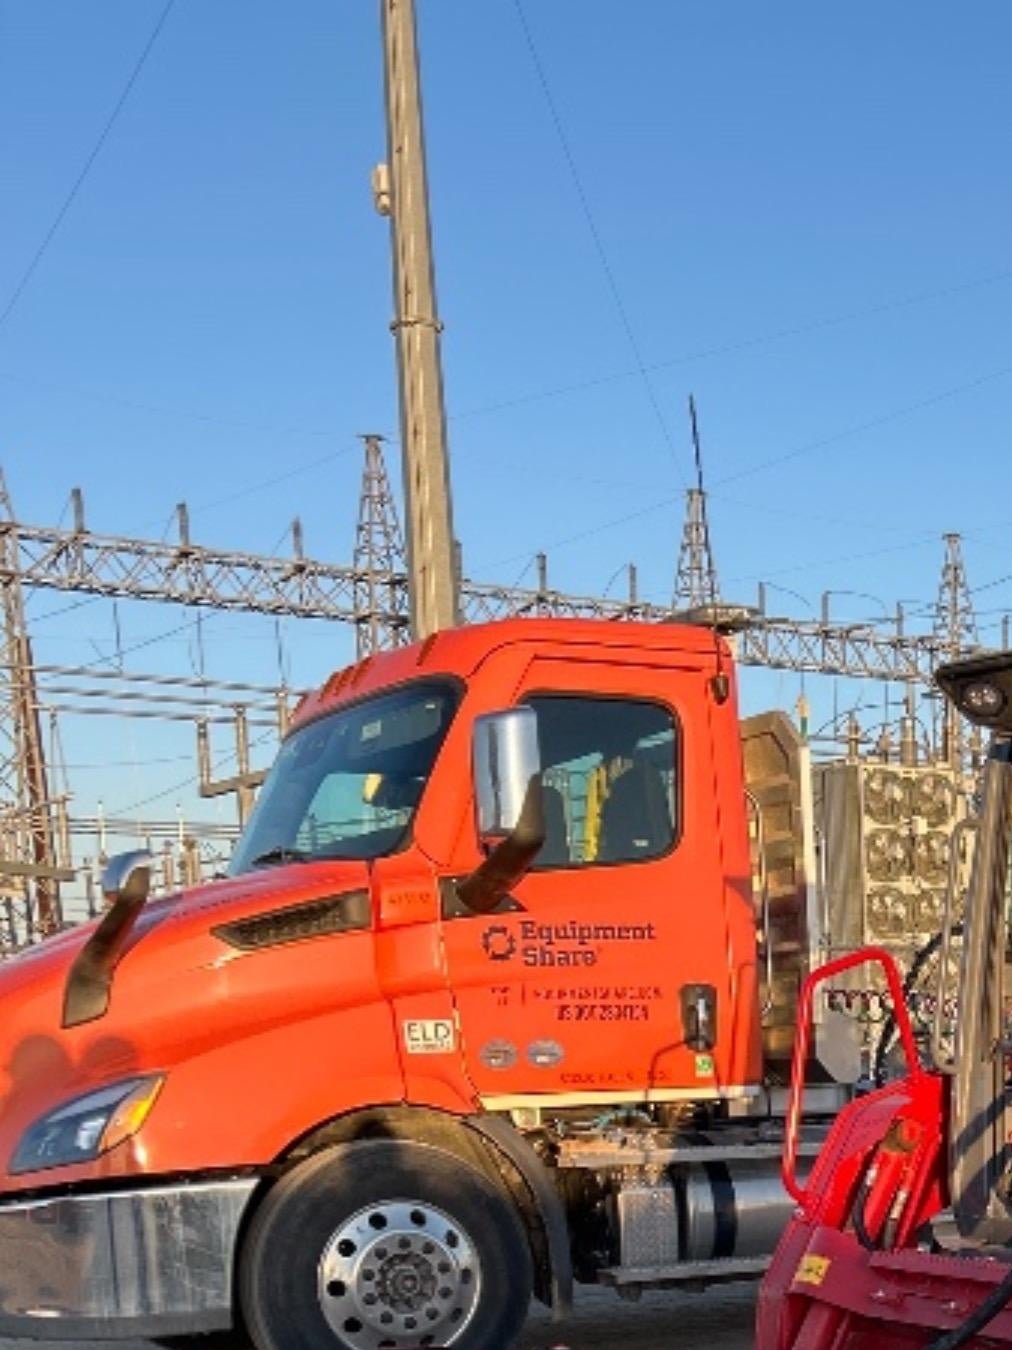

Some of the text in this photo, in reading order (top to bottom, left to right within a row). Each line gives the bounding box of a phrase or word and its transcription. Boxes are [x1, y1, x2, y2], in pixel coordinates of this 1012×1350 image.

[520, 920, 656, 944] Equipment
[523, 946, 597, 967] Share
[407, 1023, 451, 1042] ELD
